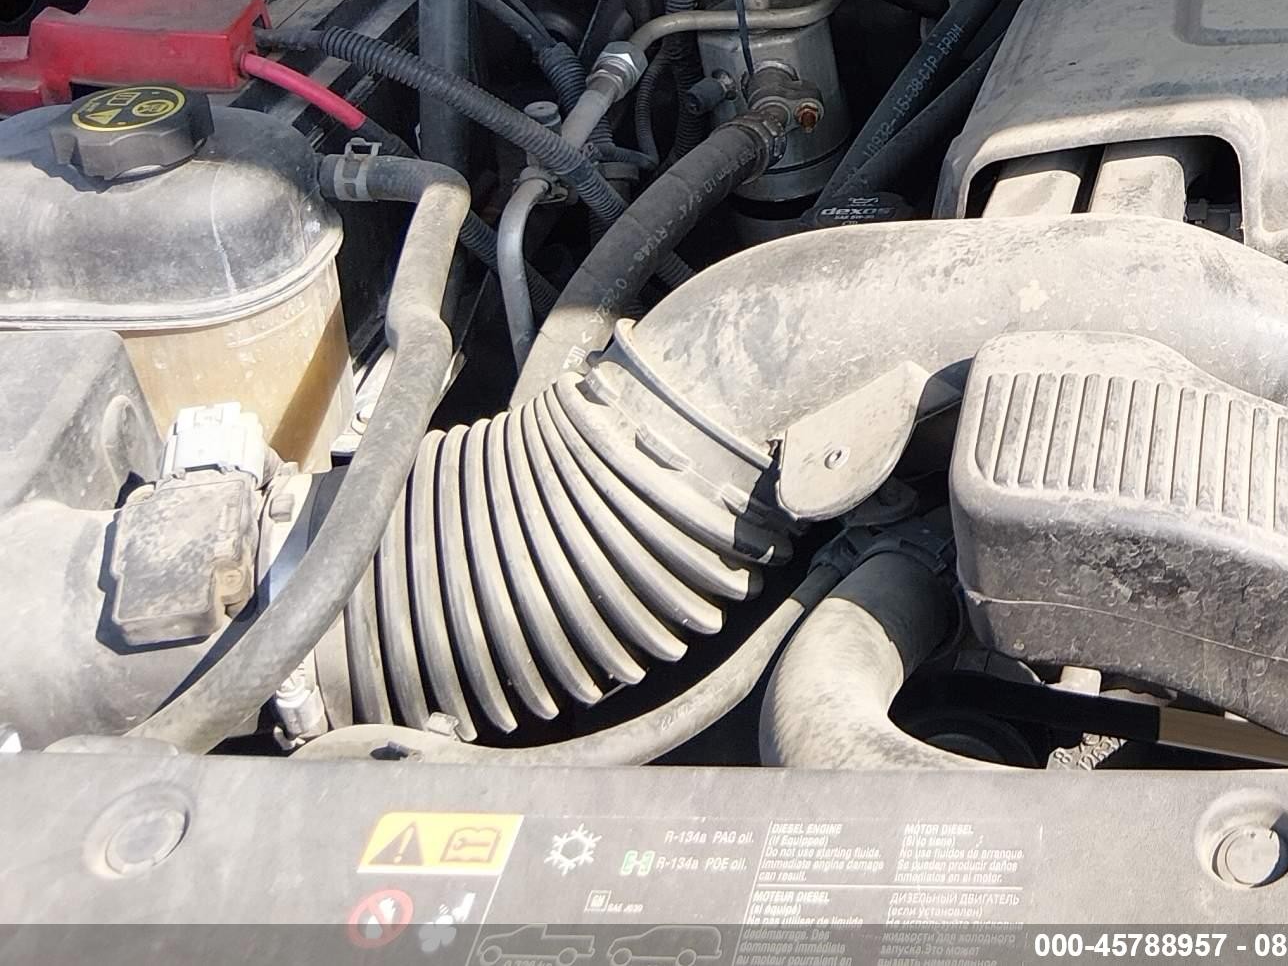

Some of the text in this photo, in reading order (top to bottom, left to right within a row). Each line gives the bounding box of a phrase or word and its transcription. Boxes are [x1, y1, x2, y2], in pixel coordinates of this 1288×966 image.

[772, 824, 843, 835] DIESEL ENGINE
[905, 824, 974, 835] MOTOR DIESEL
[664, 831, 754, 843] R-134a PAG oil.
[766, 846, 882, 859] Do not use starting fluids.
[900, 848, 913, 859] No
[656, 856, 747, 870] R-134a POE oil.
[762, 859, 883, 872] Immediate engine damage
[911, 860, 946, 872] pueden
[949, 860, 987, 872] producir
[759, 871, 806, 882] can result.
[973, 873, 1002, 883] motor.
[753, 891, 830, 903] MOTEUR DIESEL
[890, 892, 1020, 906] ДИЗЕЛЬНЫЙ ДВИГАТЕЛЬ
[887, 906, 983, 919] (если установлен)
